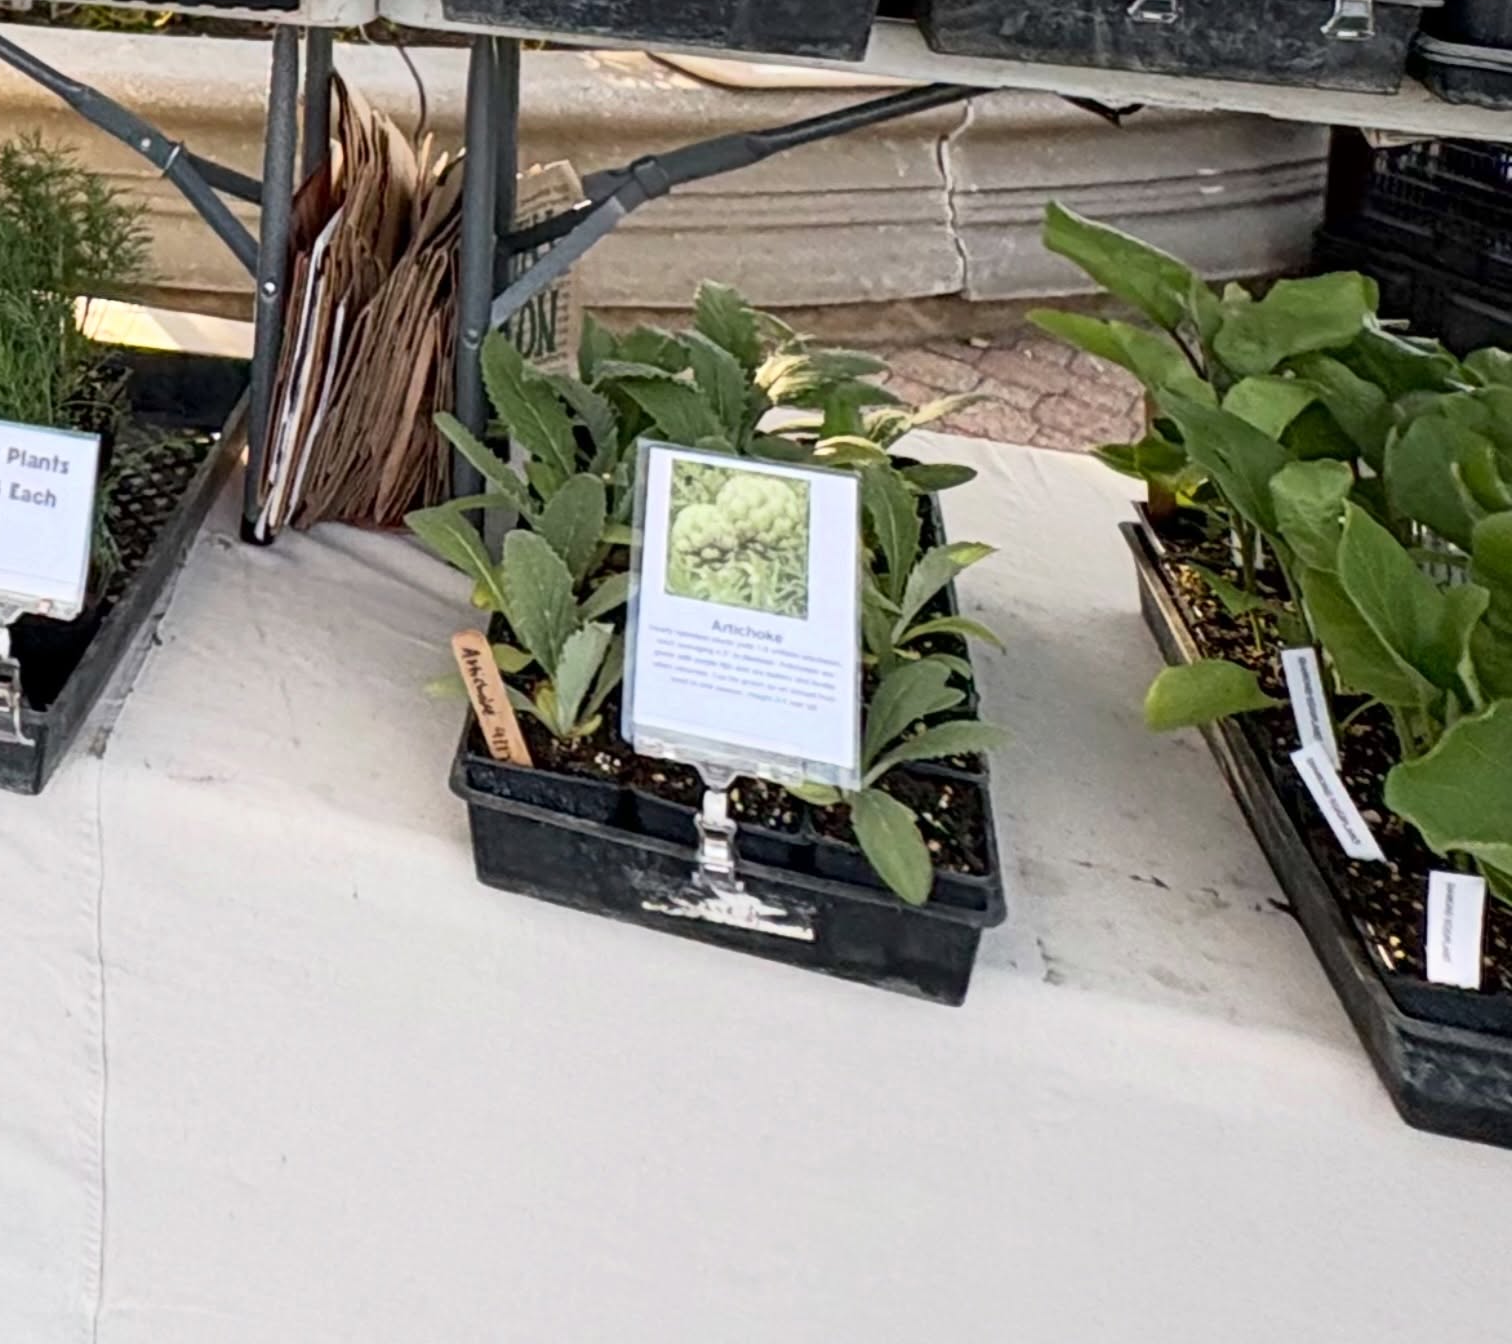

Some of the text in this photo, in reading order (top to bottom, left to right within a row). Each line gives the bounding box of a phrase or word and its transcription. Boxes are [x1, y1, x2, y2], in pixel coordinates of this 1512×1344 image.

[6, 446, 70, 475] Plants
[9, 483, 57, 508] Each
[712, 620, 783, 643] Artichoke
